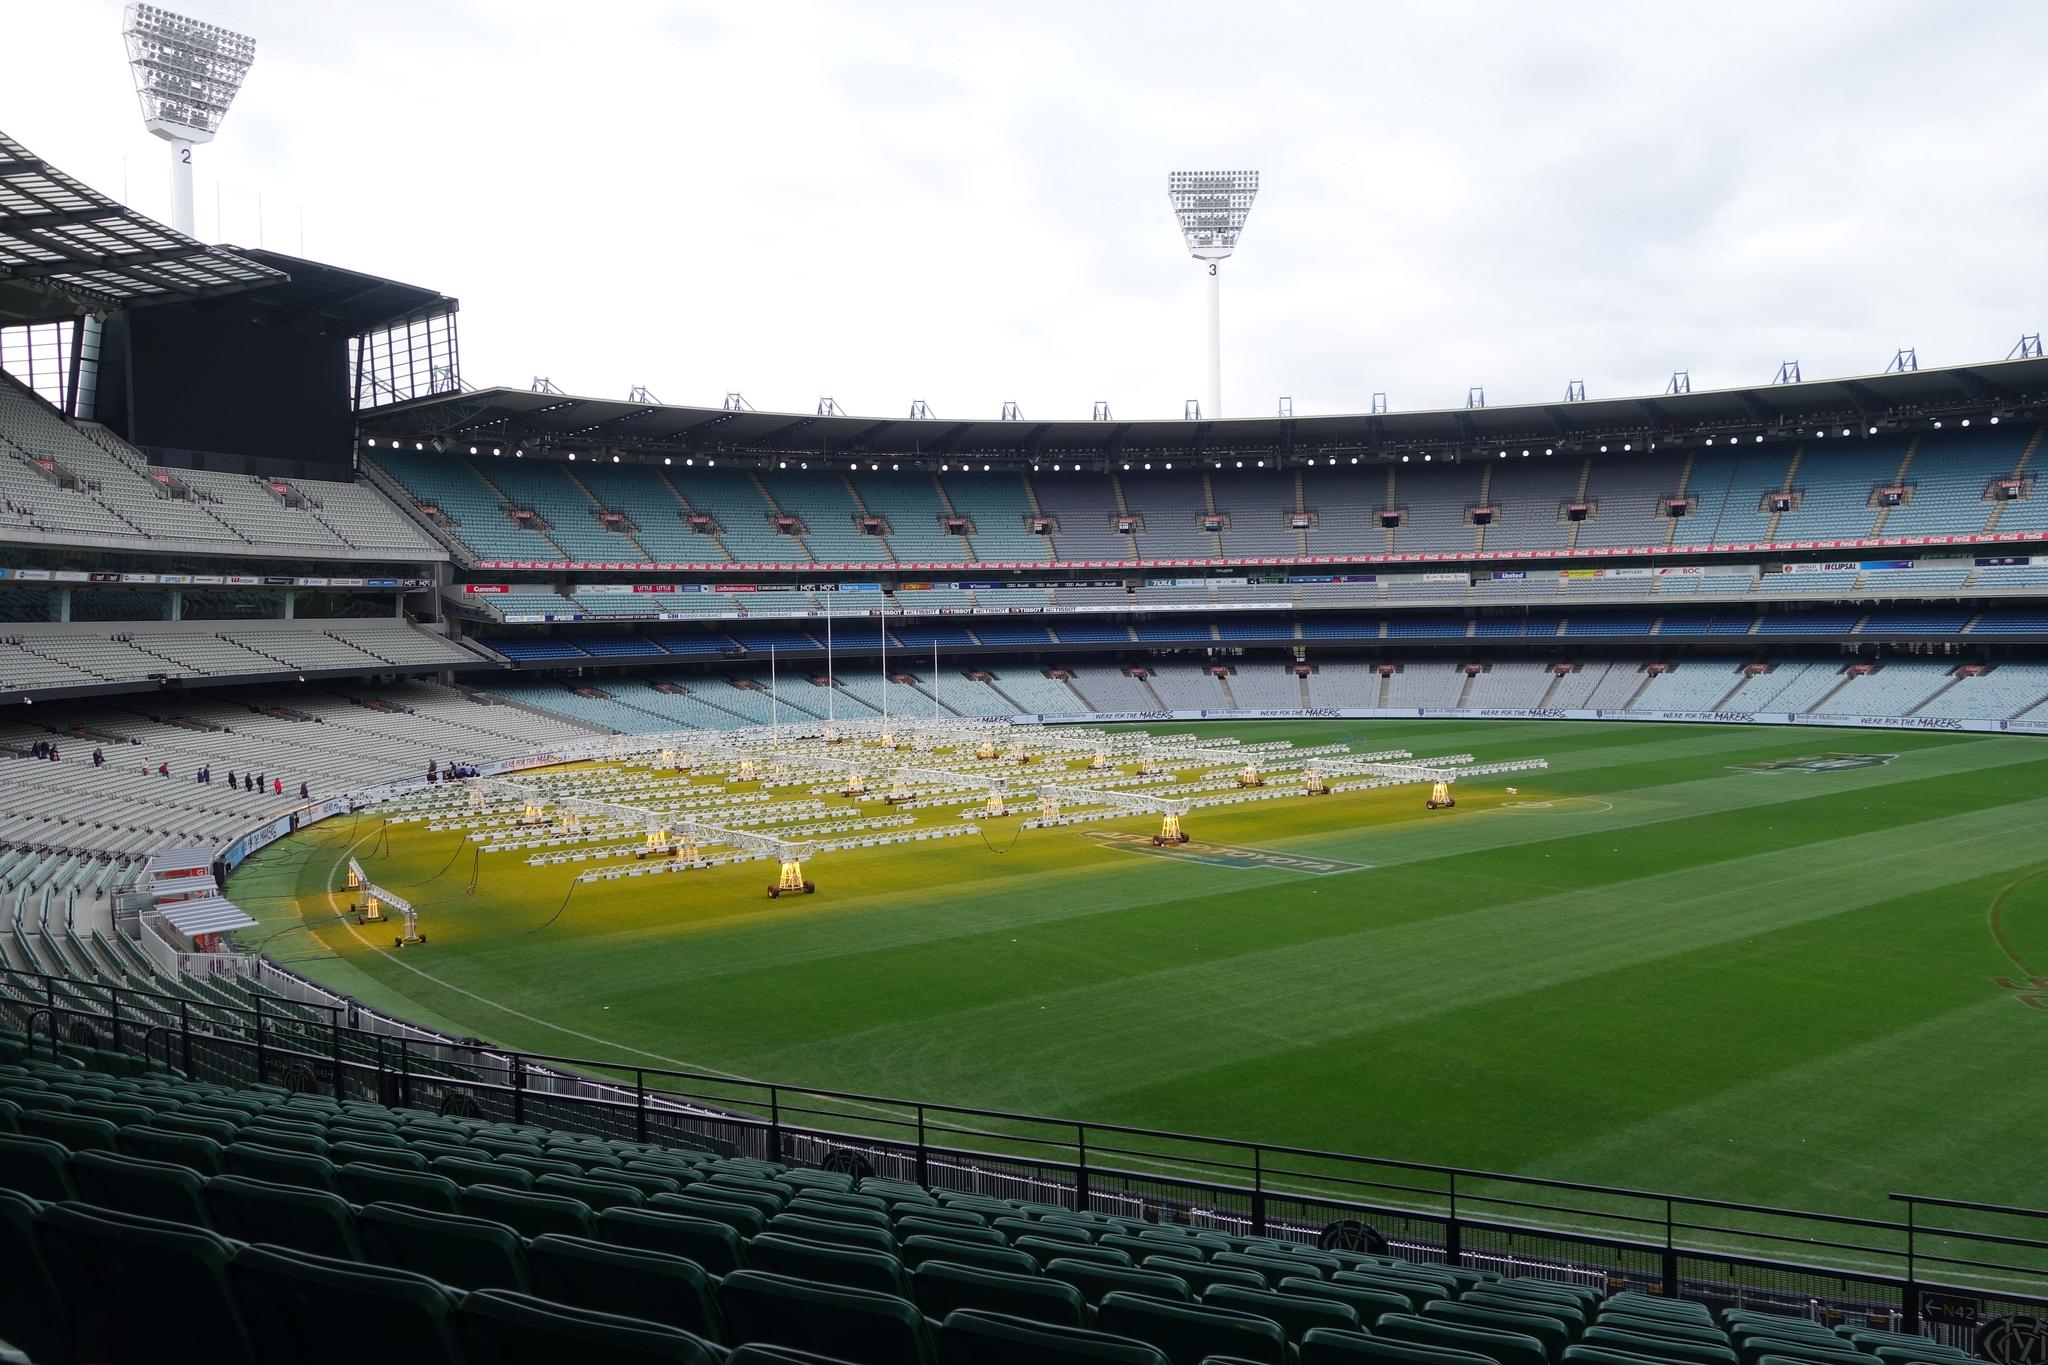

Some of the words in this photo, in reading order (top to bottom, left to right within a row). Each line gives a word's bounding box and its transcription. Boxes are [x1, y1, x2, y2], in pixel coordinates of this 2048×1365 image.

[181, 148, 191, 164] 2
[1209, 263, 1217, 276] 3
[1901, 718, 1915, 726] THE
[1943, 1303, 1975, 1320] N42
